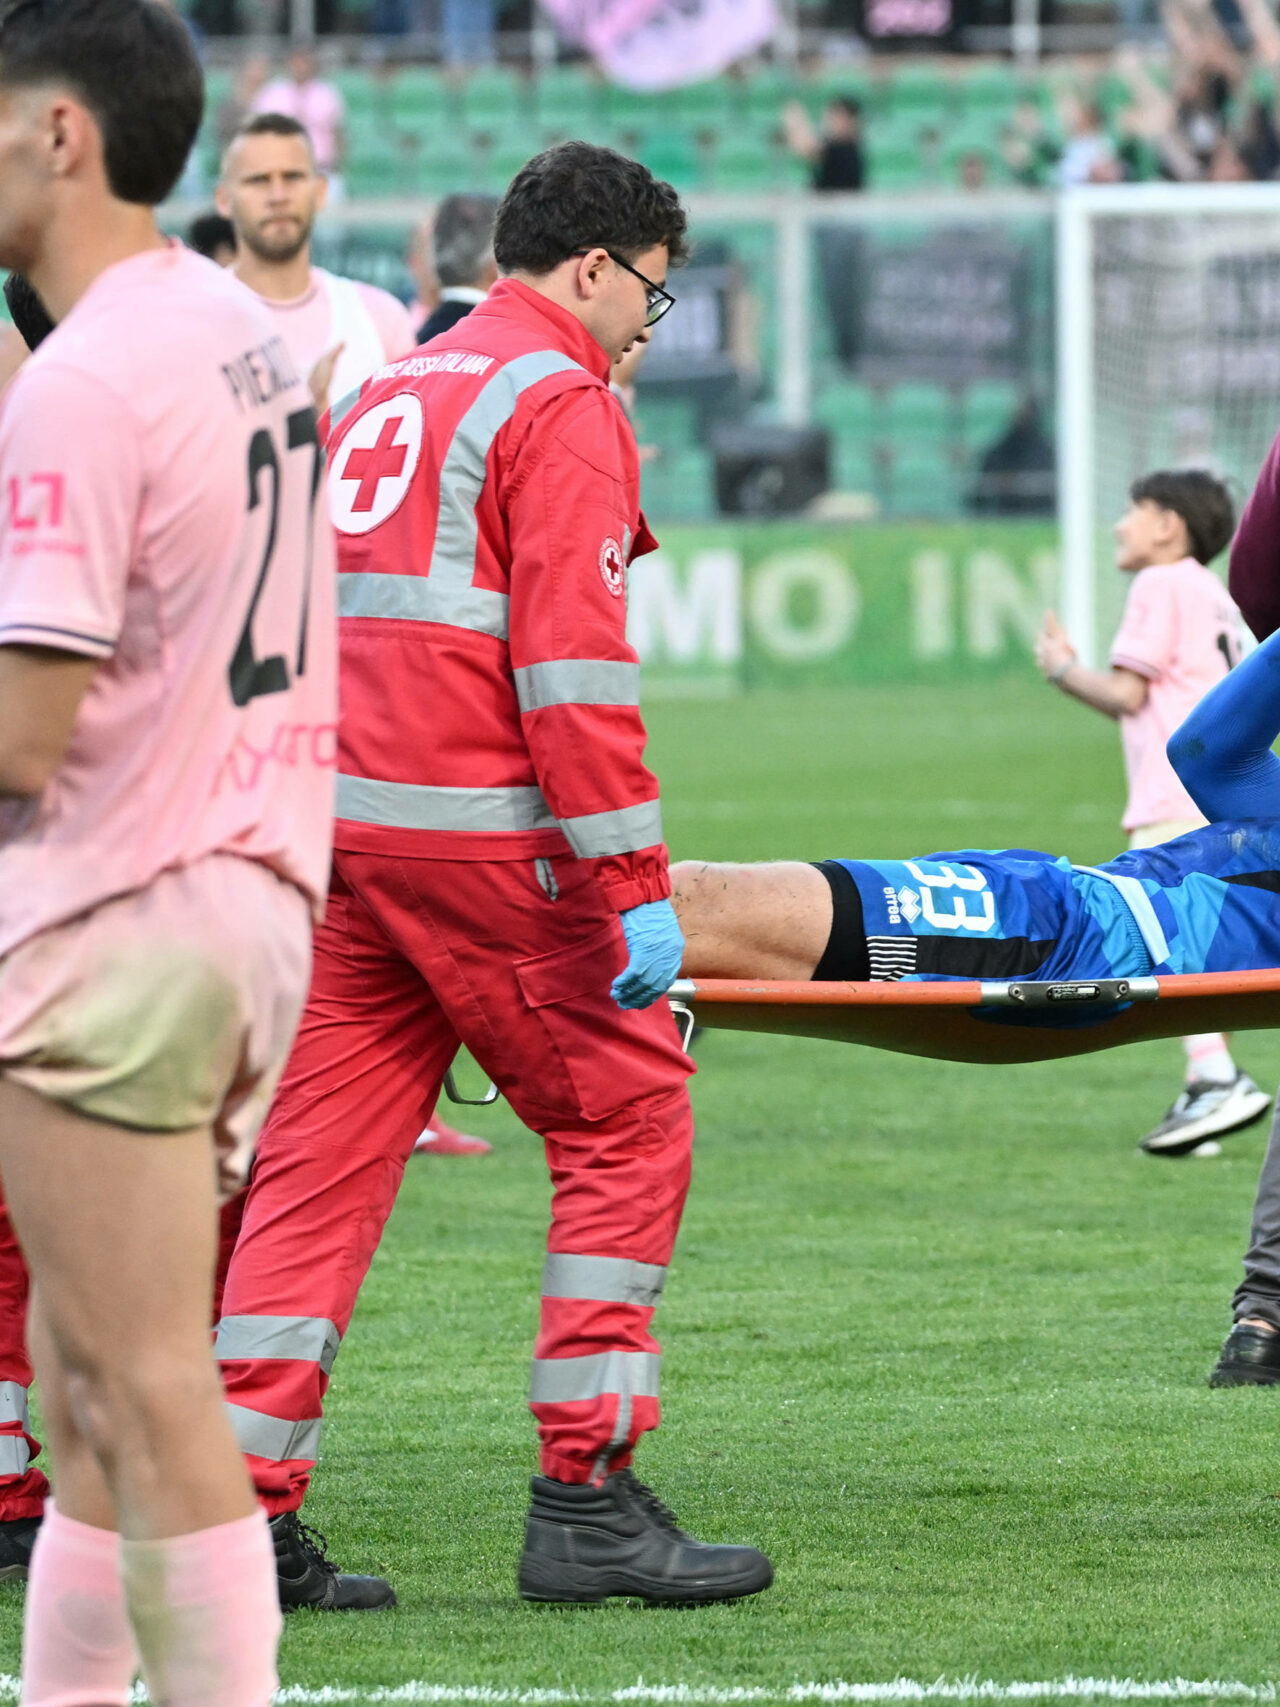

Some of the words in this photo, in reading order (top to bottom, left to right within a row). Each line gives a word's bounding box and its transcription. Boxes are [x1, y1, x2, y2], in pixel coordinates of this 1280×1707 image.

[436, 353, 496, 376] ITALIANA
[228, 406, 324, 707] 27
[902, 861, 995, 932] 33
